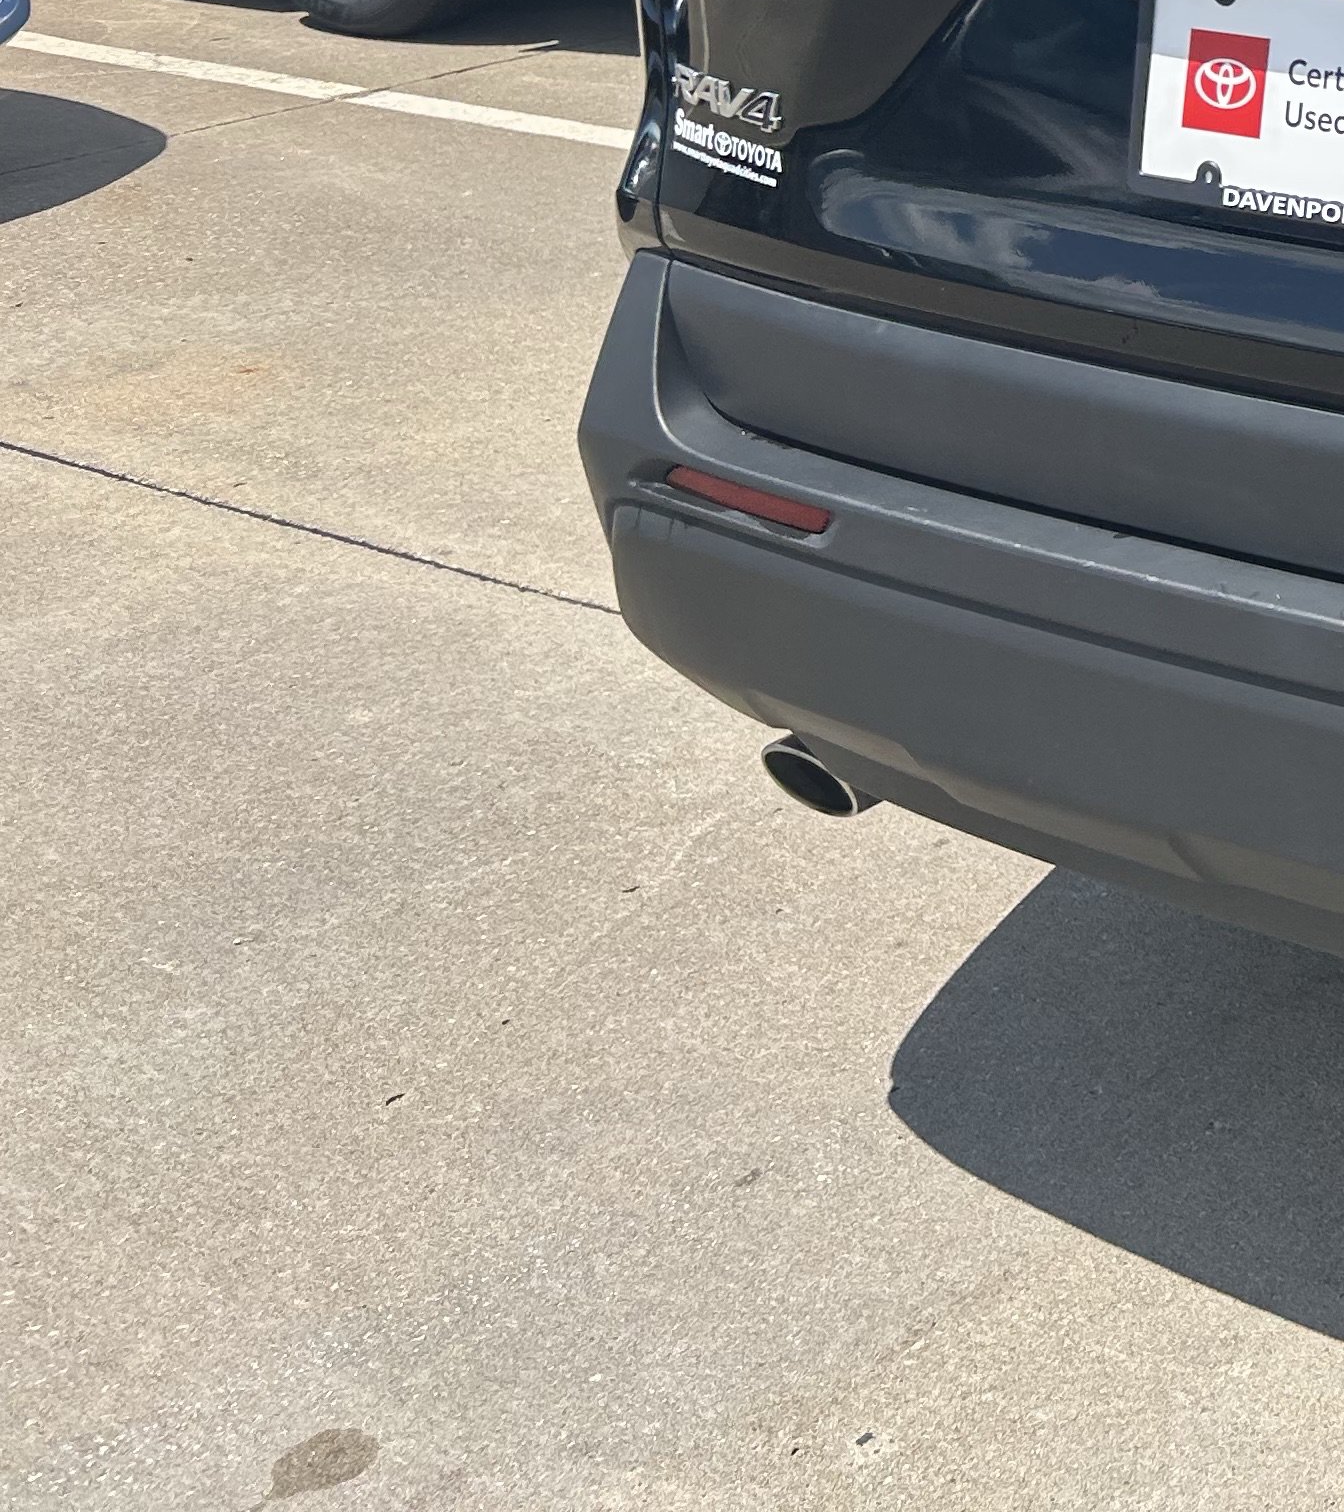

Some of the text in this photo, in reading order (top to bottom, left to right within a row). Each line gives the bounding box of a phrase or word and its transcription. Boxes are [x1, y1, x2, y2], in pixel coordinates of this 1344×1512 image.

[671, 62, 785, 134] RAV4
[674, 107, 715, 150] Smart
[731, 137, 783, 173] TOYOTA
